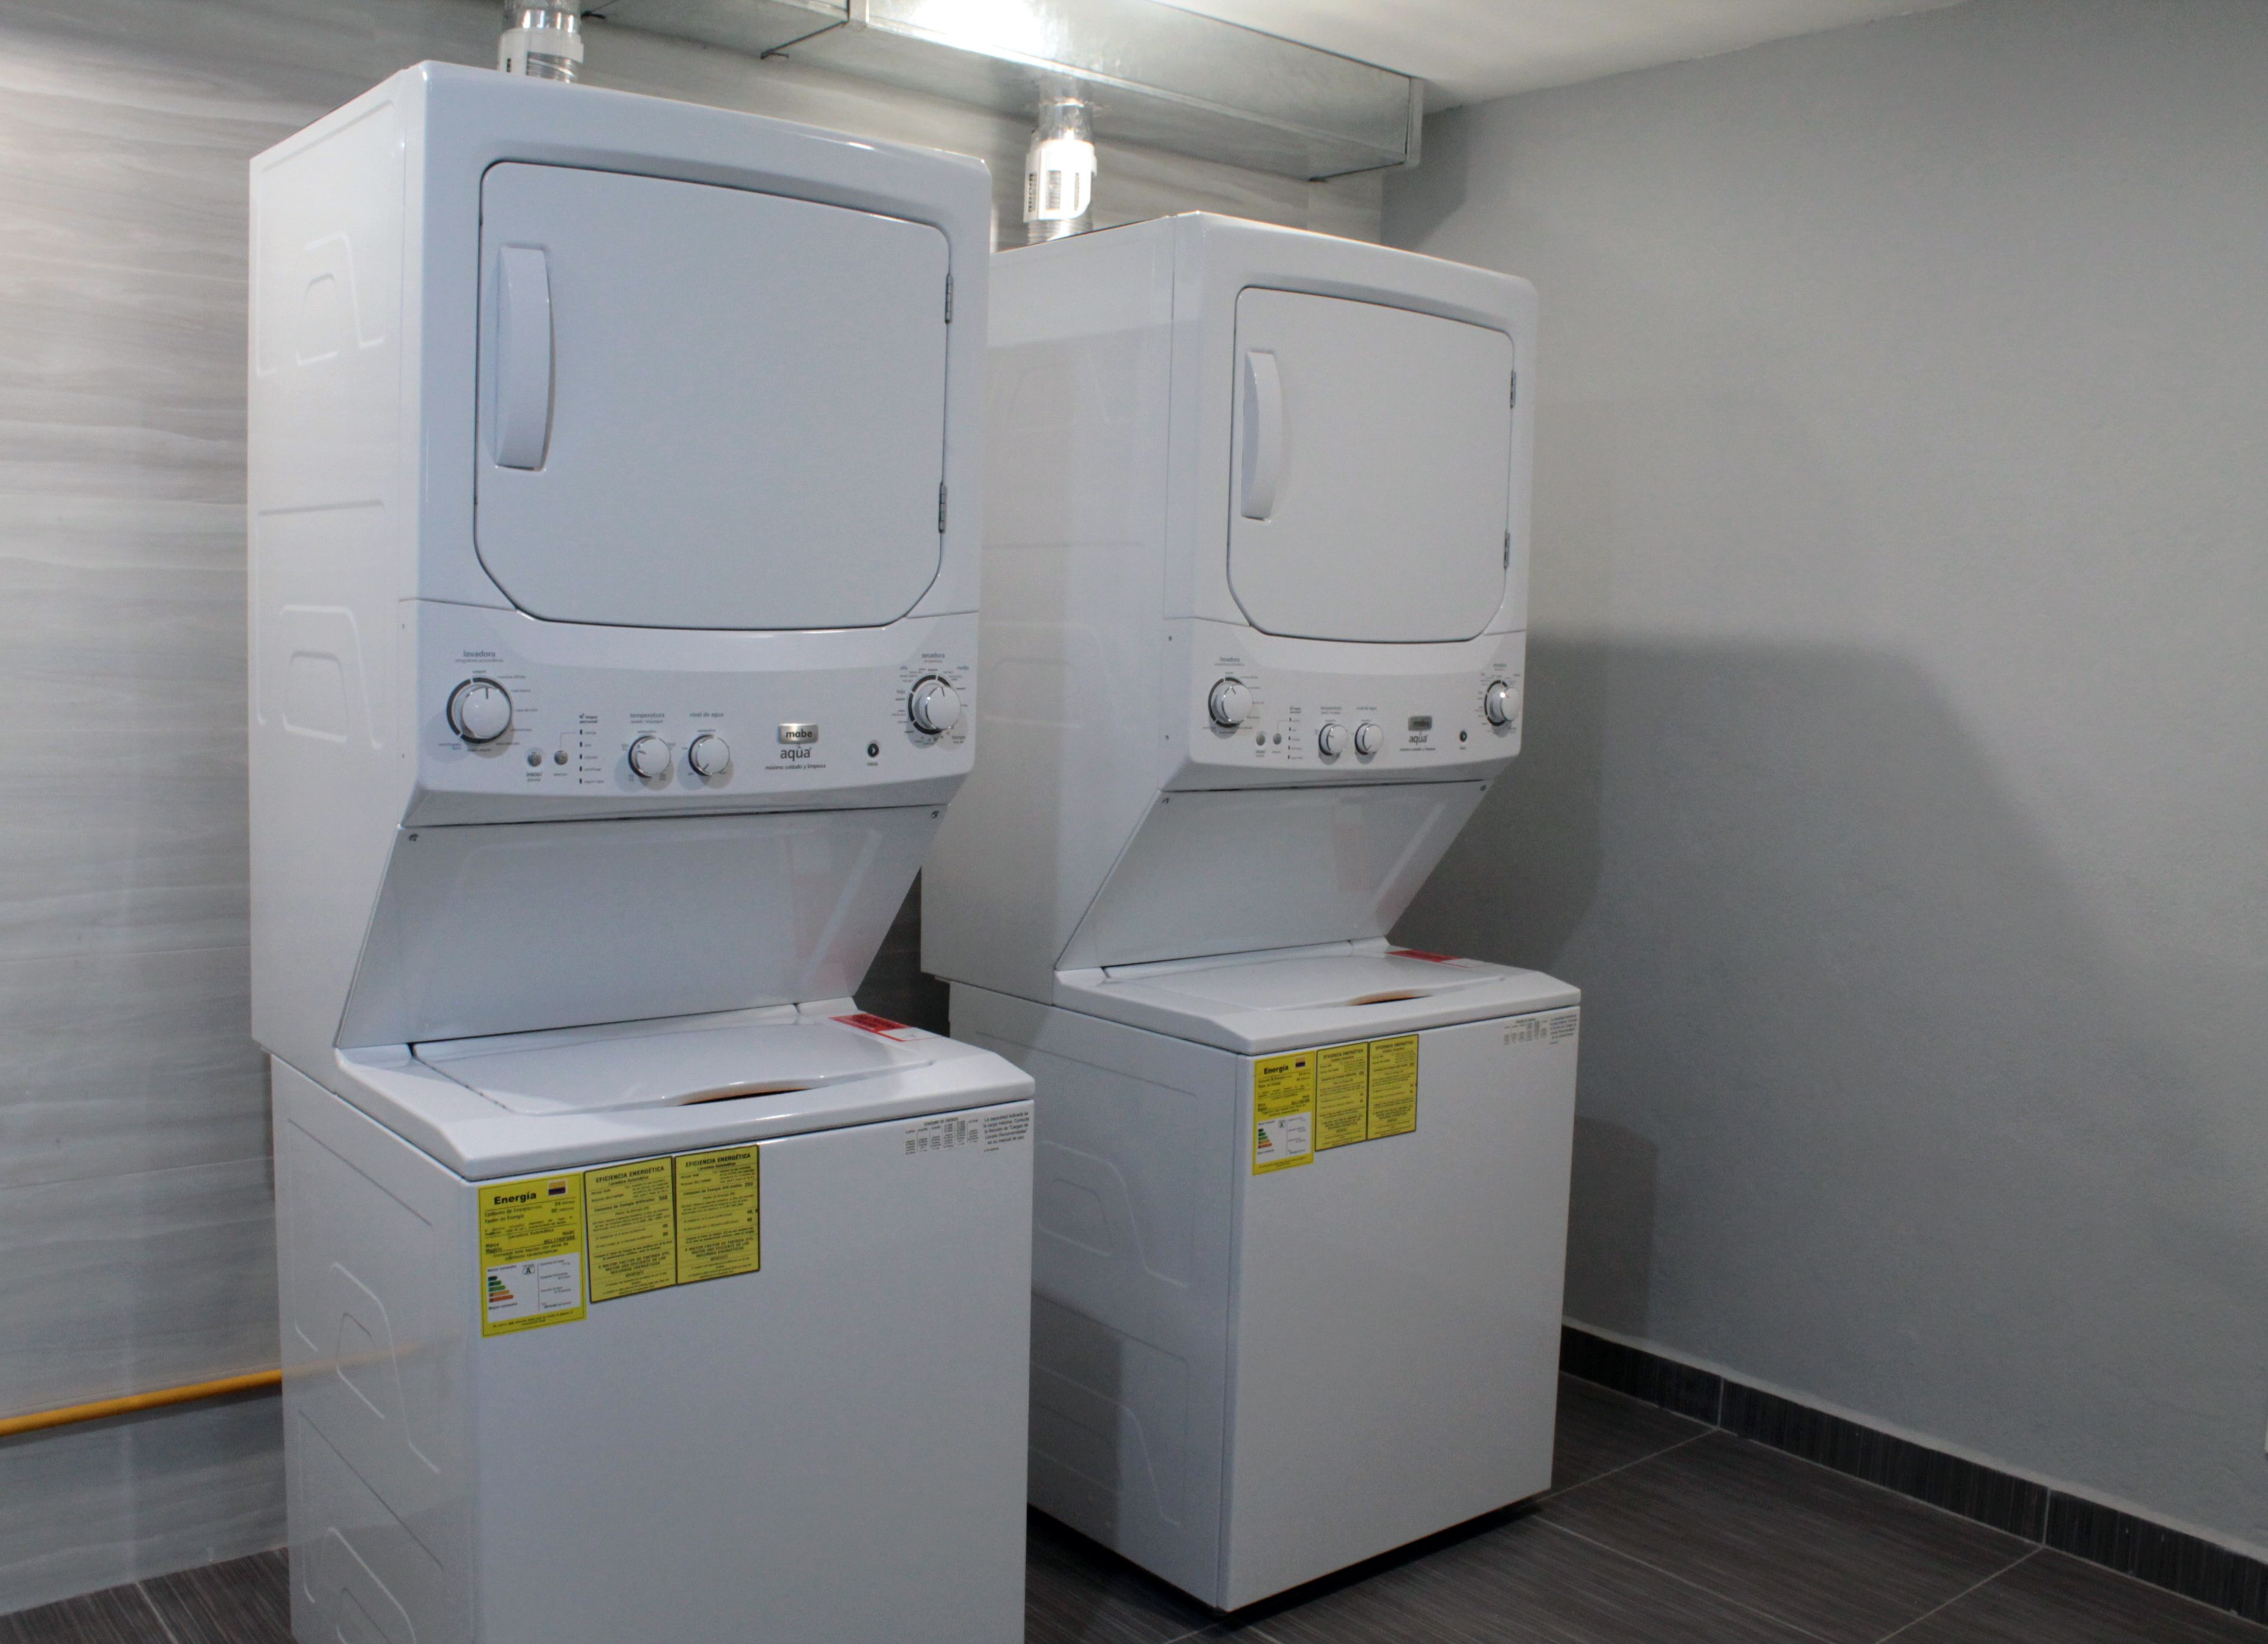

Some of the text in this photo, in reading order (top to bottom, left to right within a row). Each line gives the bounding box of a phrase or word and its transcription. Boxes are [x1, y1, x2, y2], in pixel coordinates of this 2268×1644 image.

[786, 728, 813, 738] mabe
[1264, 1065, 1289, 1074] Energía
[686, 1153, 751, 1167] EFICIENCIA ENERGÉTICA
[596, 1166, 664, 1183] EFICIENCIA ENERGÉTICA
[494, 1191, 537, 1205] Energía
